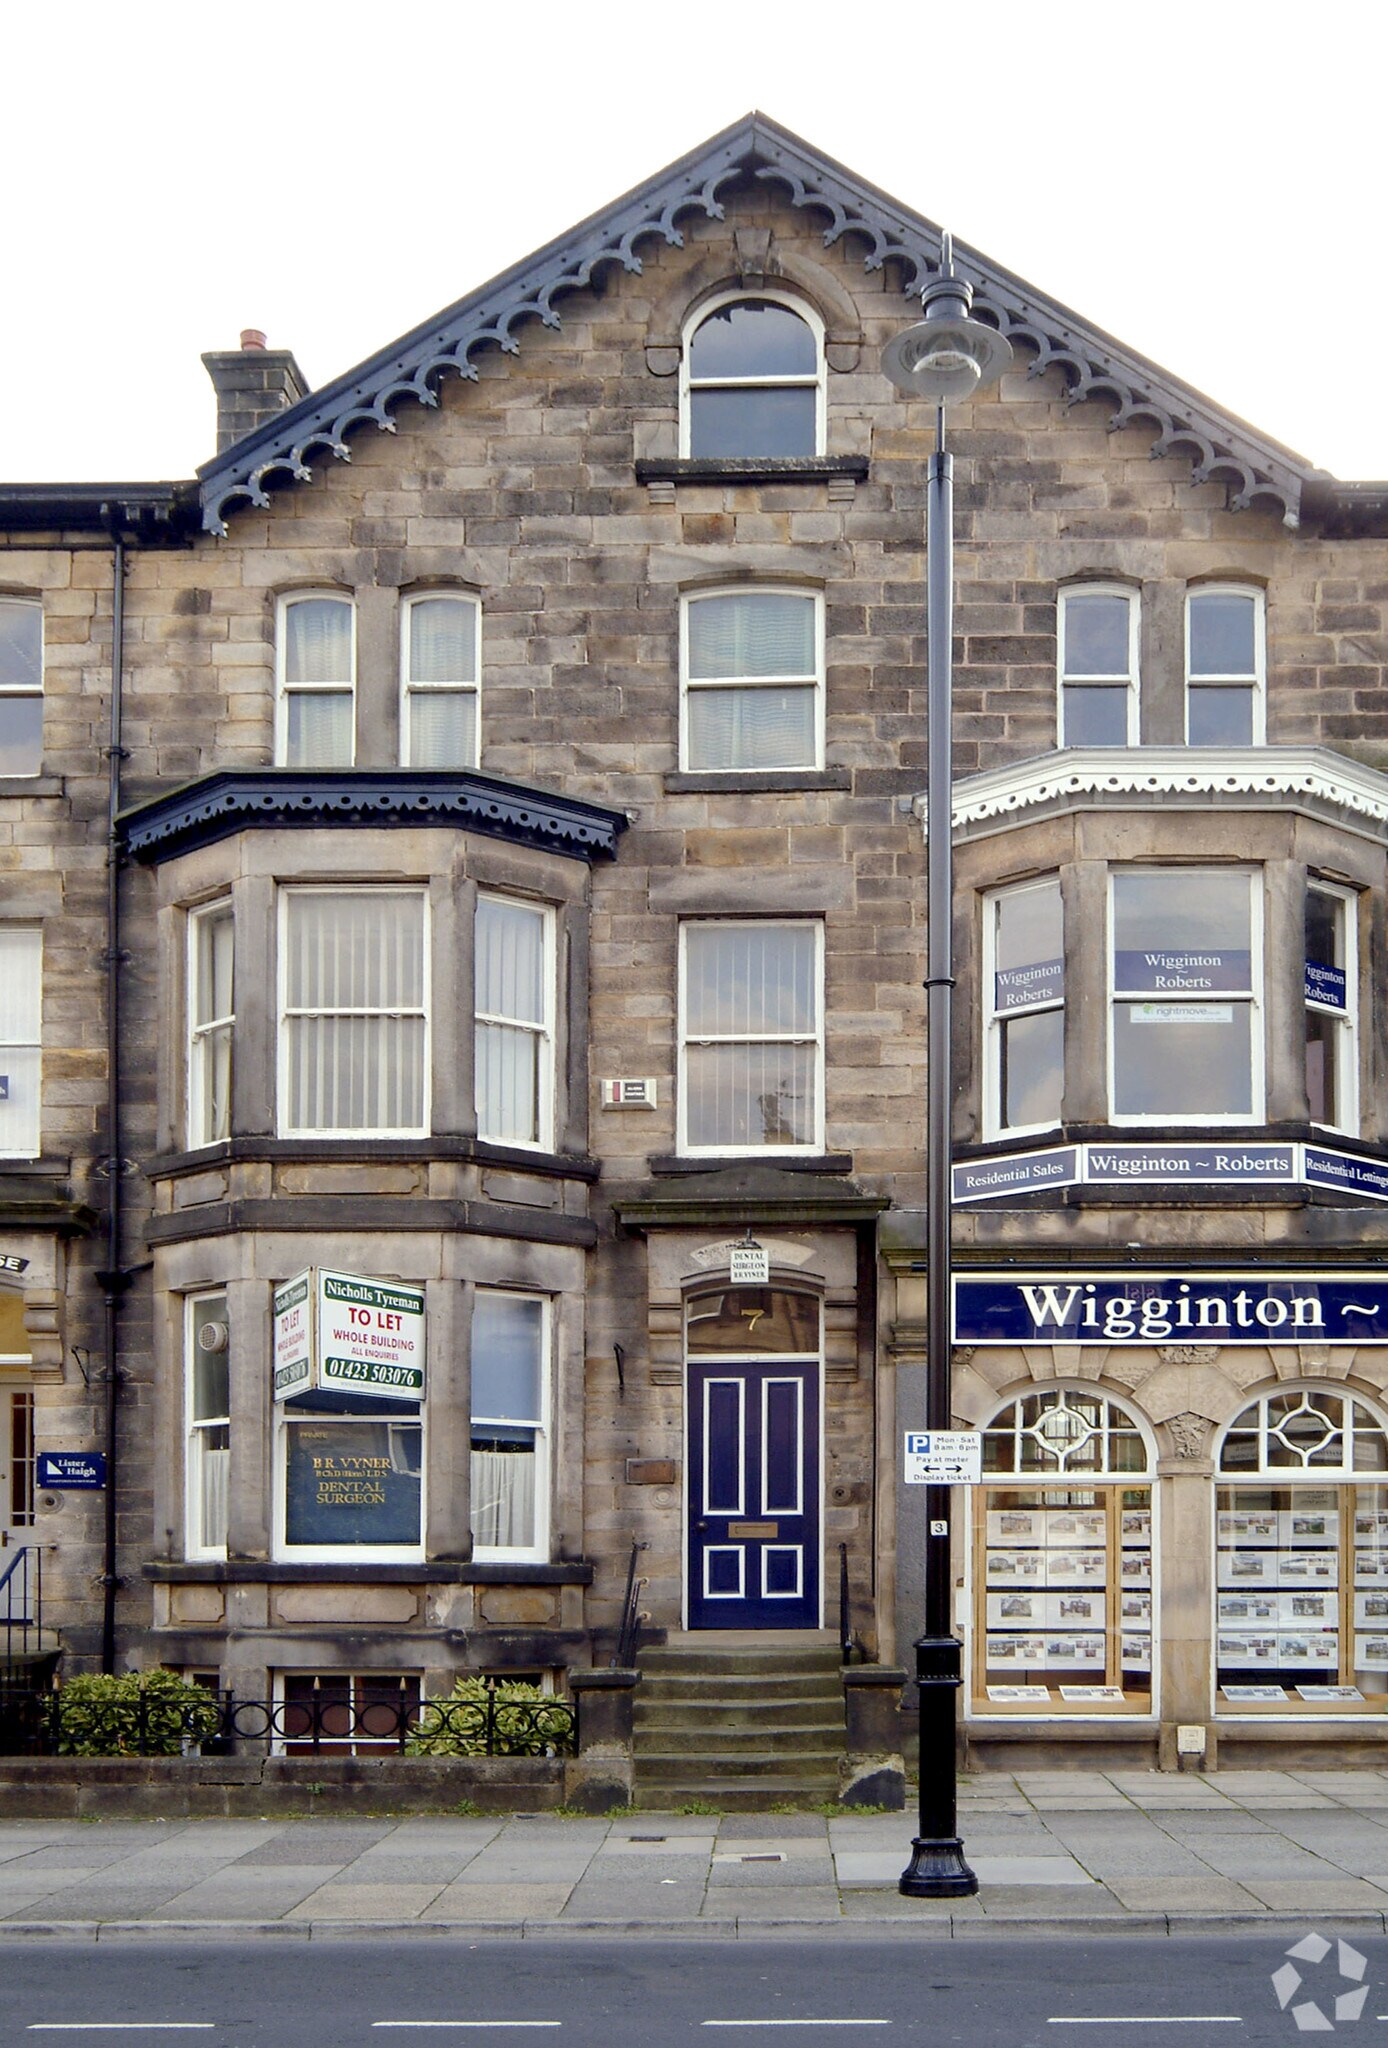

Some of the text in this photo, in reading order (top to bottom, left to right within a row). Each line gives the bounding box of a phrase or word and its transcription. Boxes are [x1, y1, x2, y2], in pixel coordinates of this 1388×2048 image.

[1144, 953, 1222, 970] Wigginton
[998, 964, 1062, 986] Wigginton
[1155, 975, 1212, 988] Roberts
[1006, 988, 1053, 1006] Roberts
[1305, 983, 1339, 1004] Roberts
[966, 1162, 1064, 1188] Residential Sales
[1090, 1154, 1191, 1175] Wigginton
[1214, 1154, 1290, 1171] Roberts
[1306, 1157, 1355, 1179] Residential
[326, 1280, 373, 1302] Nicholls
[374, 1289, 420, 1310] Tyreman
[348, 1306, 403, 1331] TO LET
[741, 1308, 765, 1331] 7
[1017, 1284, 1326, 1338] Wigginton
[333, 1329, 415, 1351] WHOLE BUILDING
[351, 1346, 400, 1361] ALL ENQUIRIES
[329, 1359, 369, 1380] 01423
[371, 1365, 415, 1386] 503076
[913, 1436, 928, 1453] P
[67, 1467, 96, 1477] Haigh
[340, 1457, 392, 1469] VYNER
[319, 1481, 384, 1492] DENTAL
[316, 1493, 385, 1504] SURGEON
[934, 1523, 944, 1533] 3
